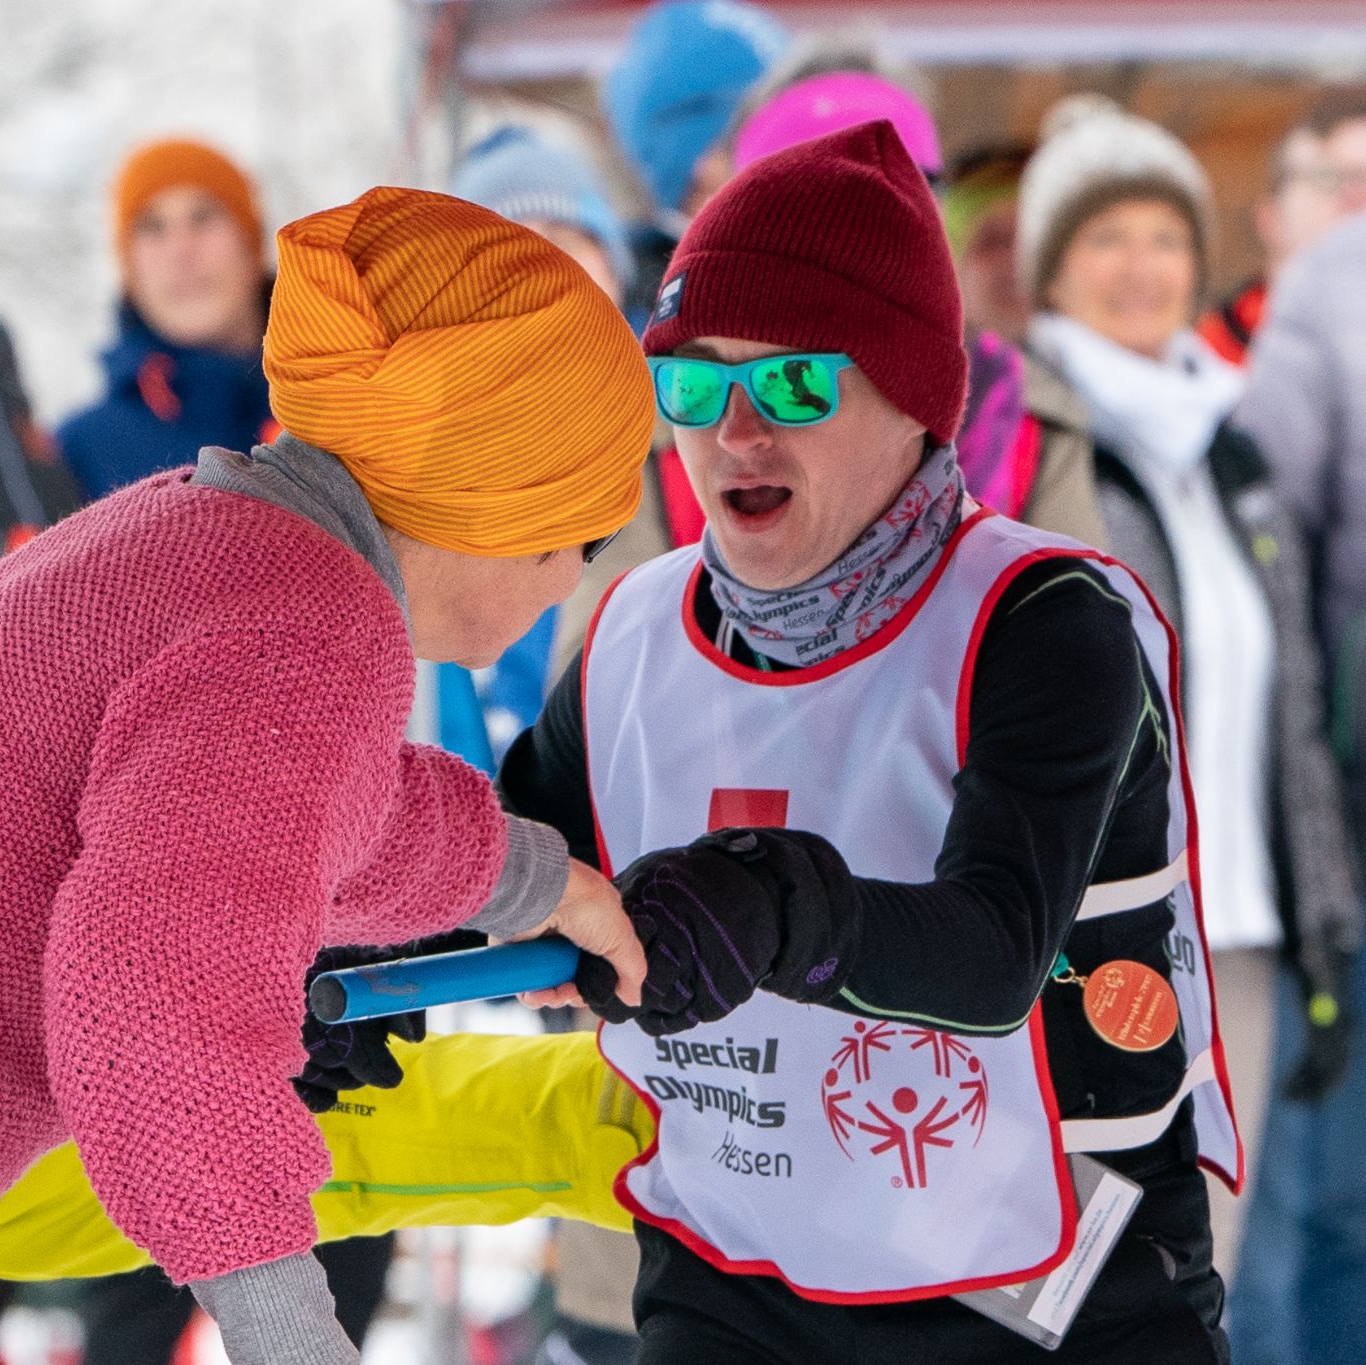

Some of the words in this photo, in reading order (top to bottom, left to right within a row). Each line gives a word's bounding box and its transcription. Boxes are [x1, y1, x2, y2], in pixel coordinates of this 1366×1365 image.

[654, 1036, 779, 1075] Special
[644, 1074, 786, 1129] Olympics
[711, 1130, 792, 1178] Hessen
